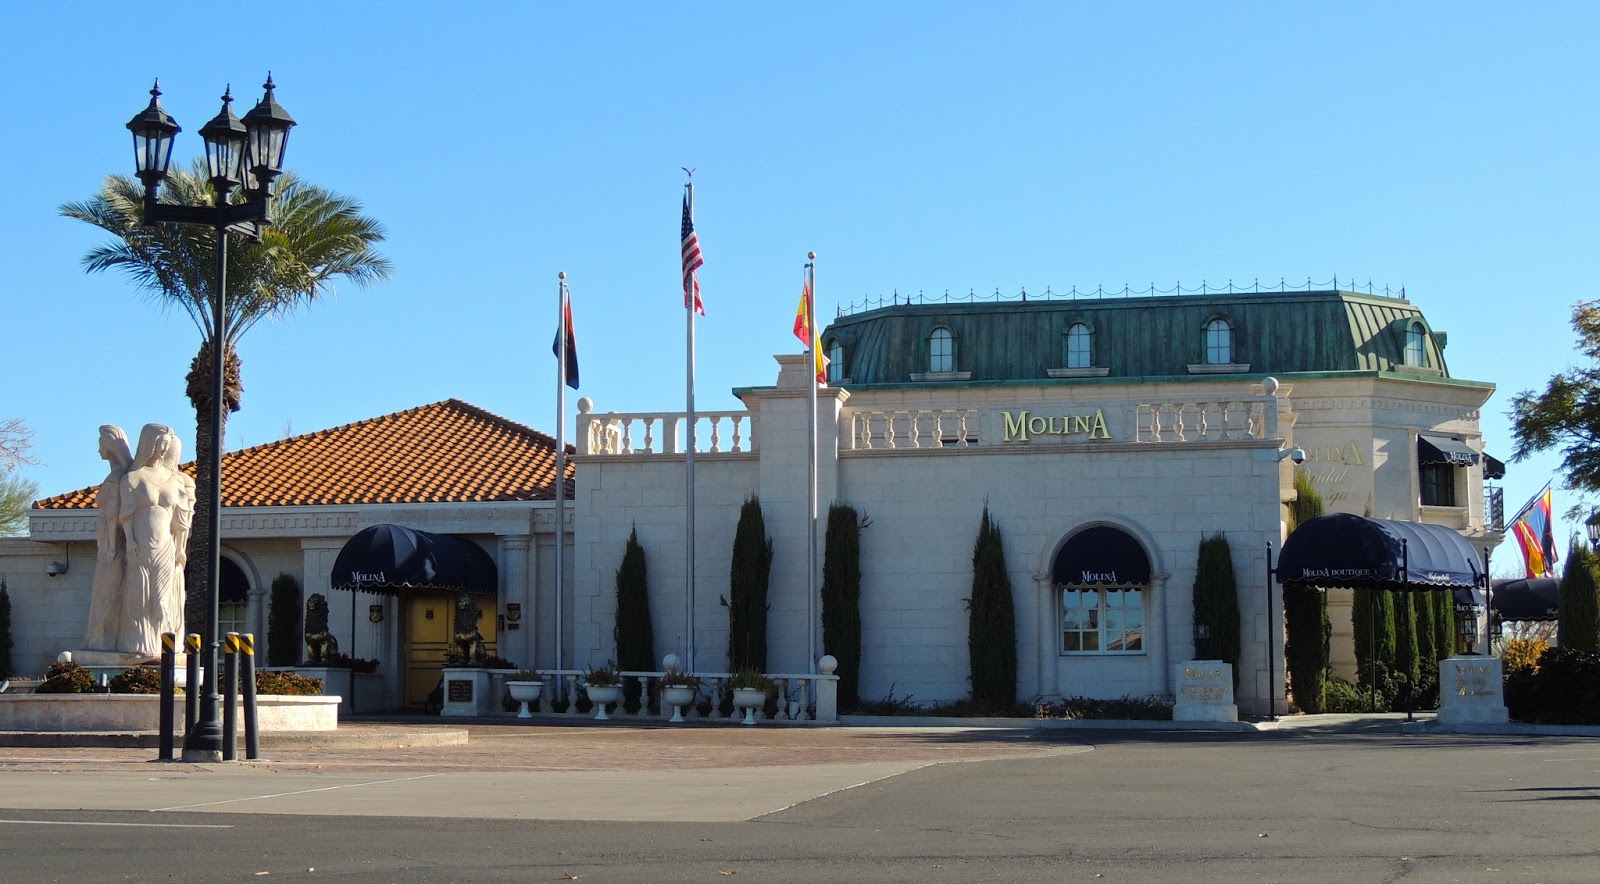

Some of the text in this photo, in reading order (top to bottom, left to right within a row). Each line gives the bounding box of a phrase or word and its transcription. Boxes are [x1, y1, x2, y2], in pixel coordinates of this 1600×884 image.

[1001, 408, 1112, 442] MOLINA
[1295, 441, 1364, 466] OLINA
[352, 571, 386, 583] MOLINA
[1082, 570, 1117, 582] MOLINA
[1302, 567, 1330, 578] MOLINA
[1331, 568, 1370, 577] BOUTIQUE
